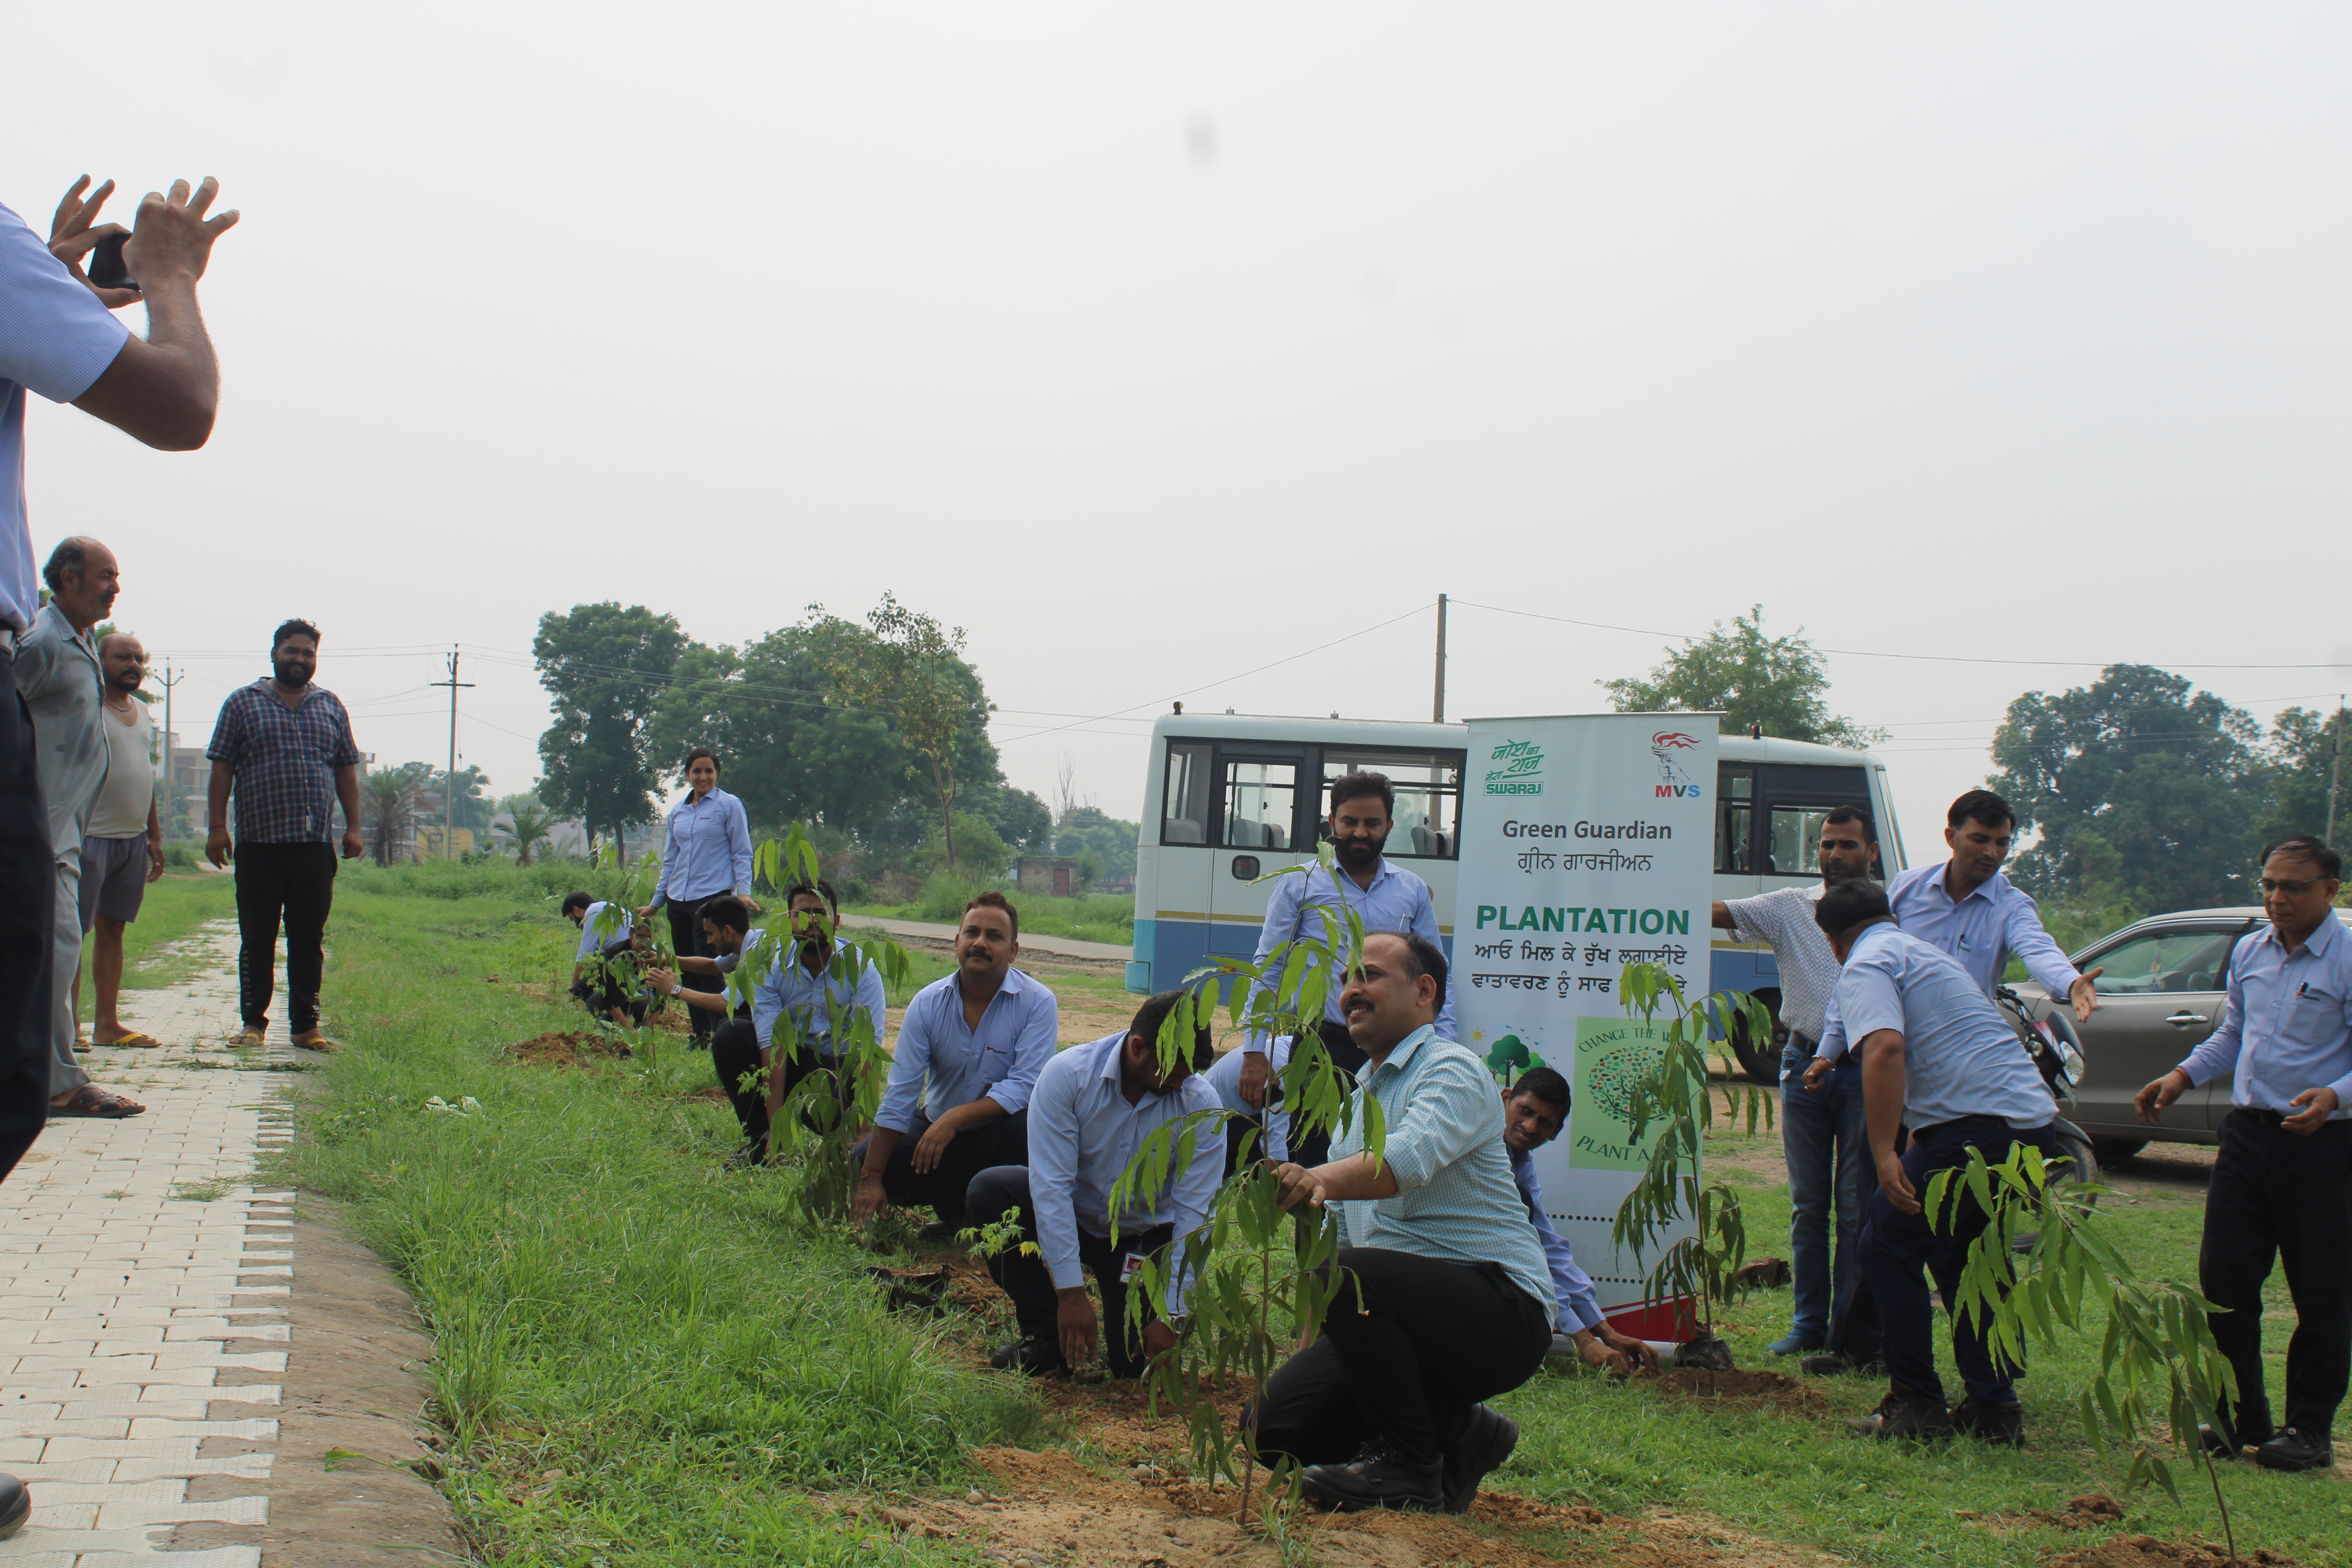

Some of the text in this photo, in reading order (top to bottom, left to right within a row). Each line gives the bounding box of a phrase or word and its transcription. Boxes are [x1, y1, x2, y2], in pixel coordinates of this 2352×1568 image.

[1491, 739, 1541, 760] जोश का
[1485, 770, 1504, 781] मेरा
[1655, 785, 1700, 798] MVS
[1503, 820, 1671, 839] Green Guardian
[1517, 847, 1653, 875] ਗ੍ਰੀਨ ਗਾਰਜੀਅਨ
[1476, 905, 1689, 935] PLANTATION
[1475, 939, 1513, 960] ਆਓ
[1521, 940, 1555, 961] ਮਿਲ
[1562, 942, 1576, 962] ਕੇ
[1584, 942, 1611, 966] ਰੁੱਖ
[1472, 973, 1550, 991] ਵਾਤਾਵਰਣ
[1557, 970, 1571, 998] ਨੂੰ
[1578, 976, 1612, 993] ਸਾਫ
[1578, 1027, 1657, 1053] CHANGE THE
[1576, 1134, 1632, 1161] PLANT
[1637, 1148, 1650, 1161] A
